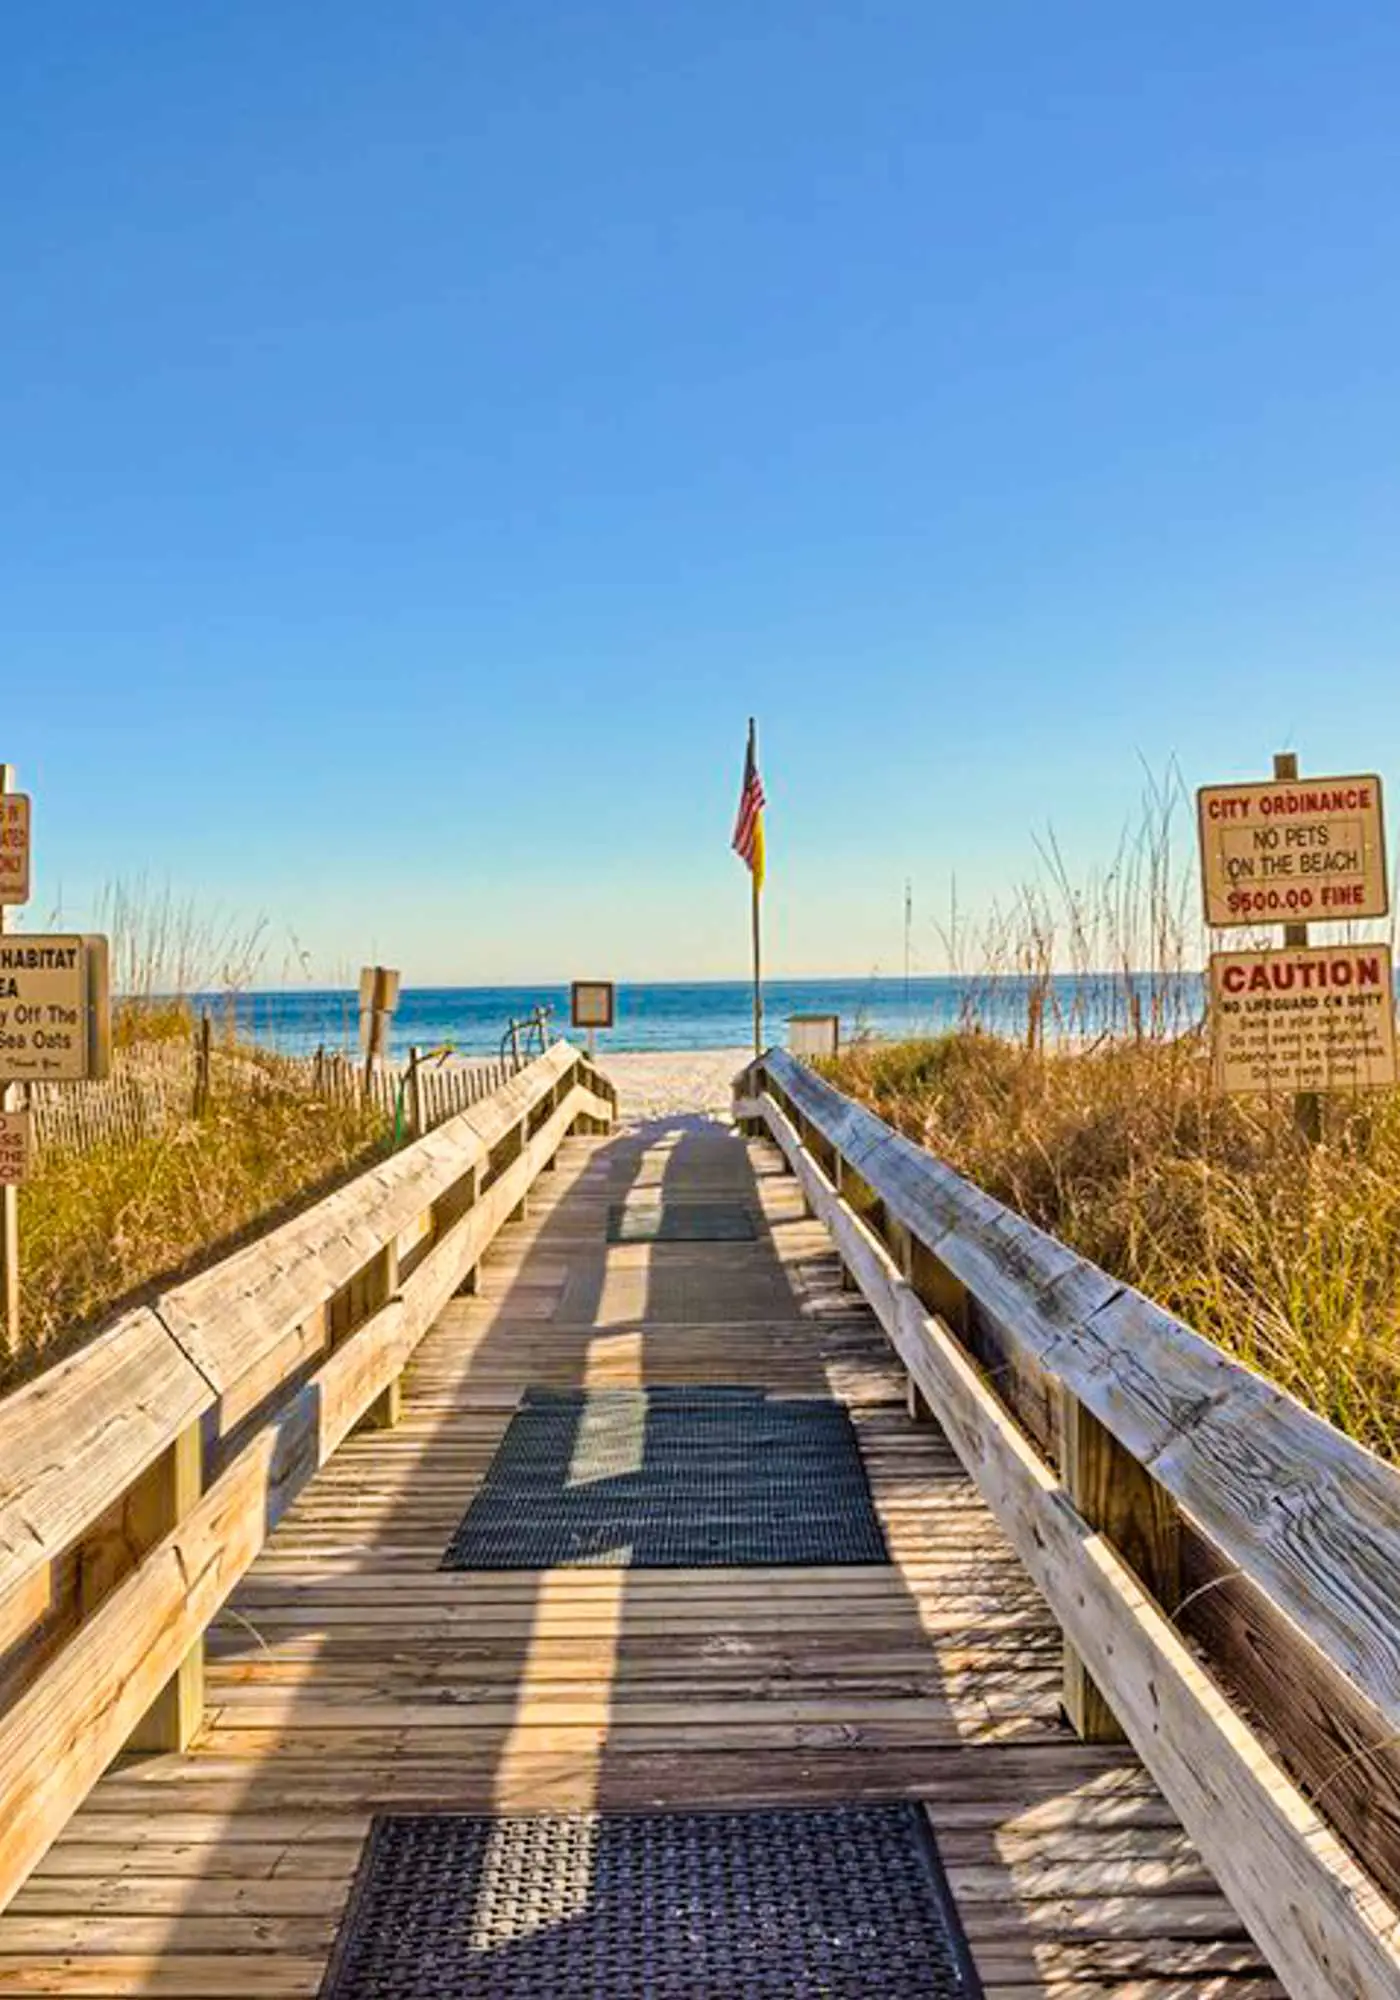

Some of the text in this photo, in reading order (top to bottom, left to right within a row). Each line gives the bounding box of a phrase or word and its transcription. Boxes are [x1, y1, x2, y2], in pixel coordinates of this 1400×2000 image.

[1209, 790, 1371, 820] CITY ORDINANCE
[1254, 825, 1330, 849] NO PETS
[1227, 851, 1358, 878] ON THE BEACH
[1227, 884, 1365, 913] $500.00 FINE
[1, 948, 77, 970] HABITAT
[1222, 957, 1380, 993] CAUTION
[14, 1003, 42, 1025] Off
[47, 1003, 77, 1025] The
[1223, 1000, 1240, 1014] NO
[1245, 997, 1318, 1012] LIFEGUARD
[1347, 992, 1383, 1007] DUTY
[0, 1030, 71, 1050] Sea Oats
